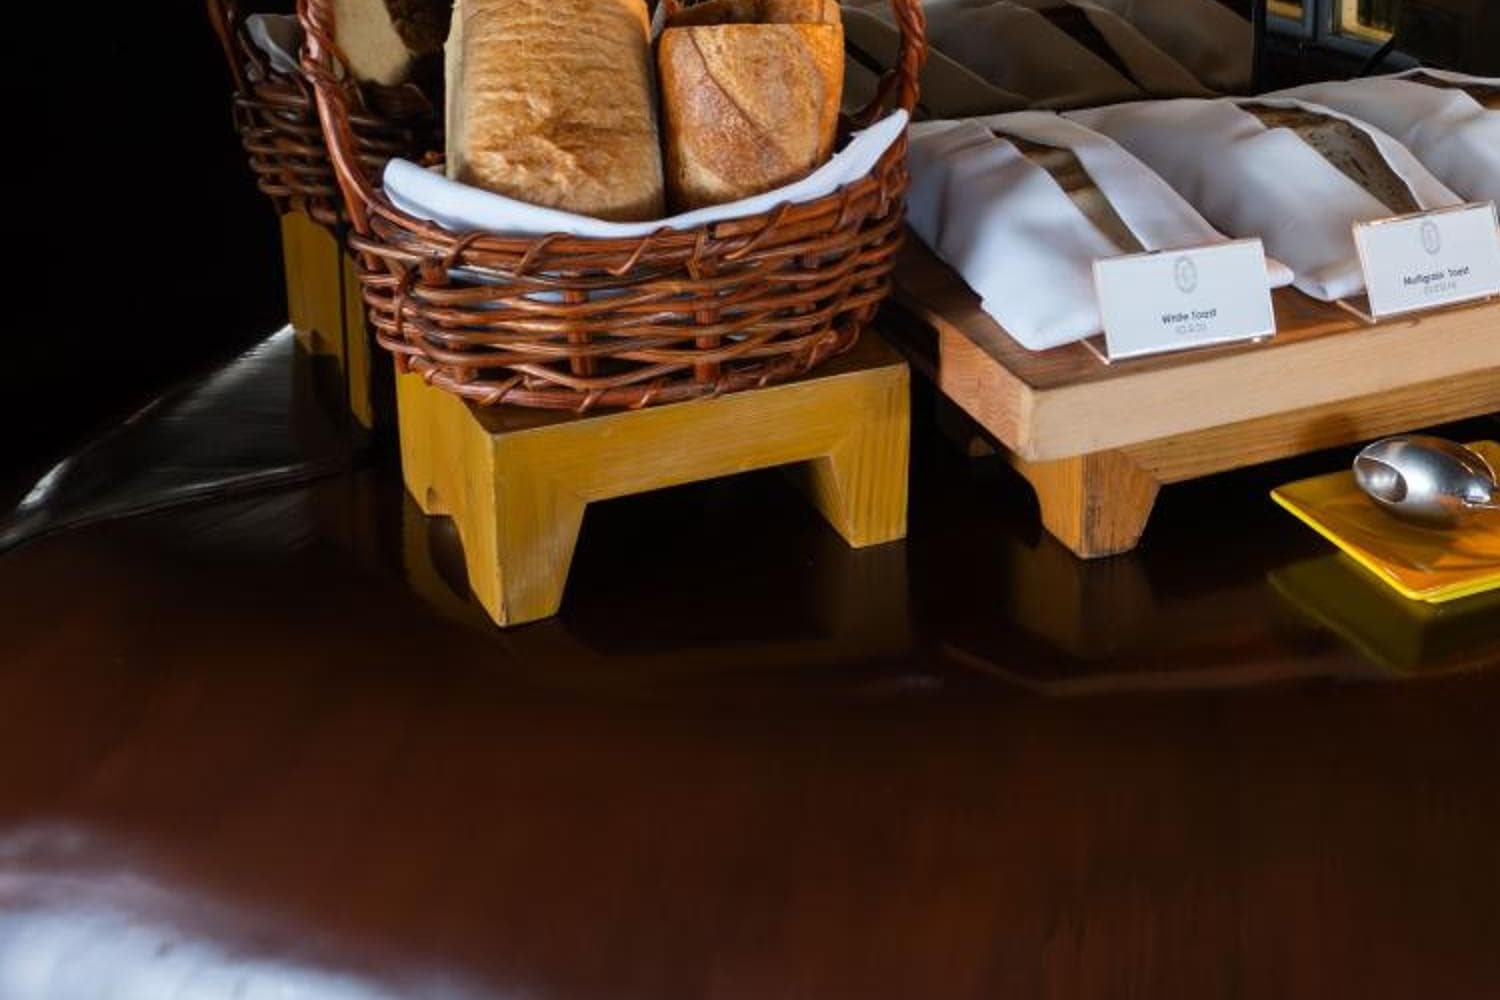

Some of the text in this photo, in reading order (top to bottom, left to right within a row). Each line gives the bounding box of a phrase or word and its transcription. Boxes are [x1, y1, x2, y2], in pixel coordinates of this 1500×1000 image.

[1447, 266, 1470, 277] Toast
[1161, 307, 1217, 324] White Toast
